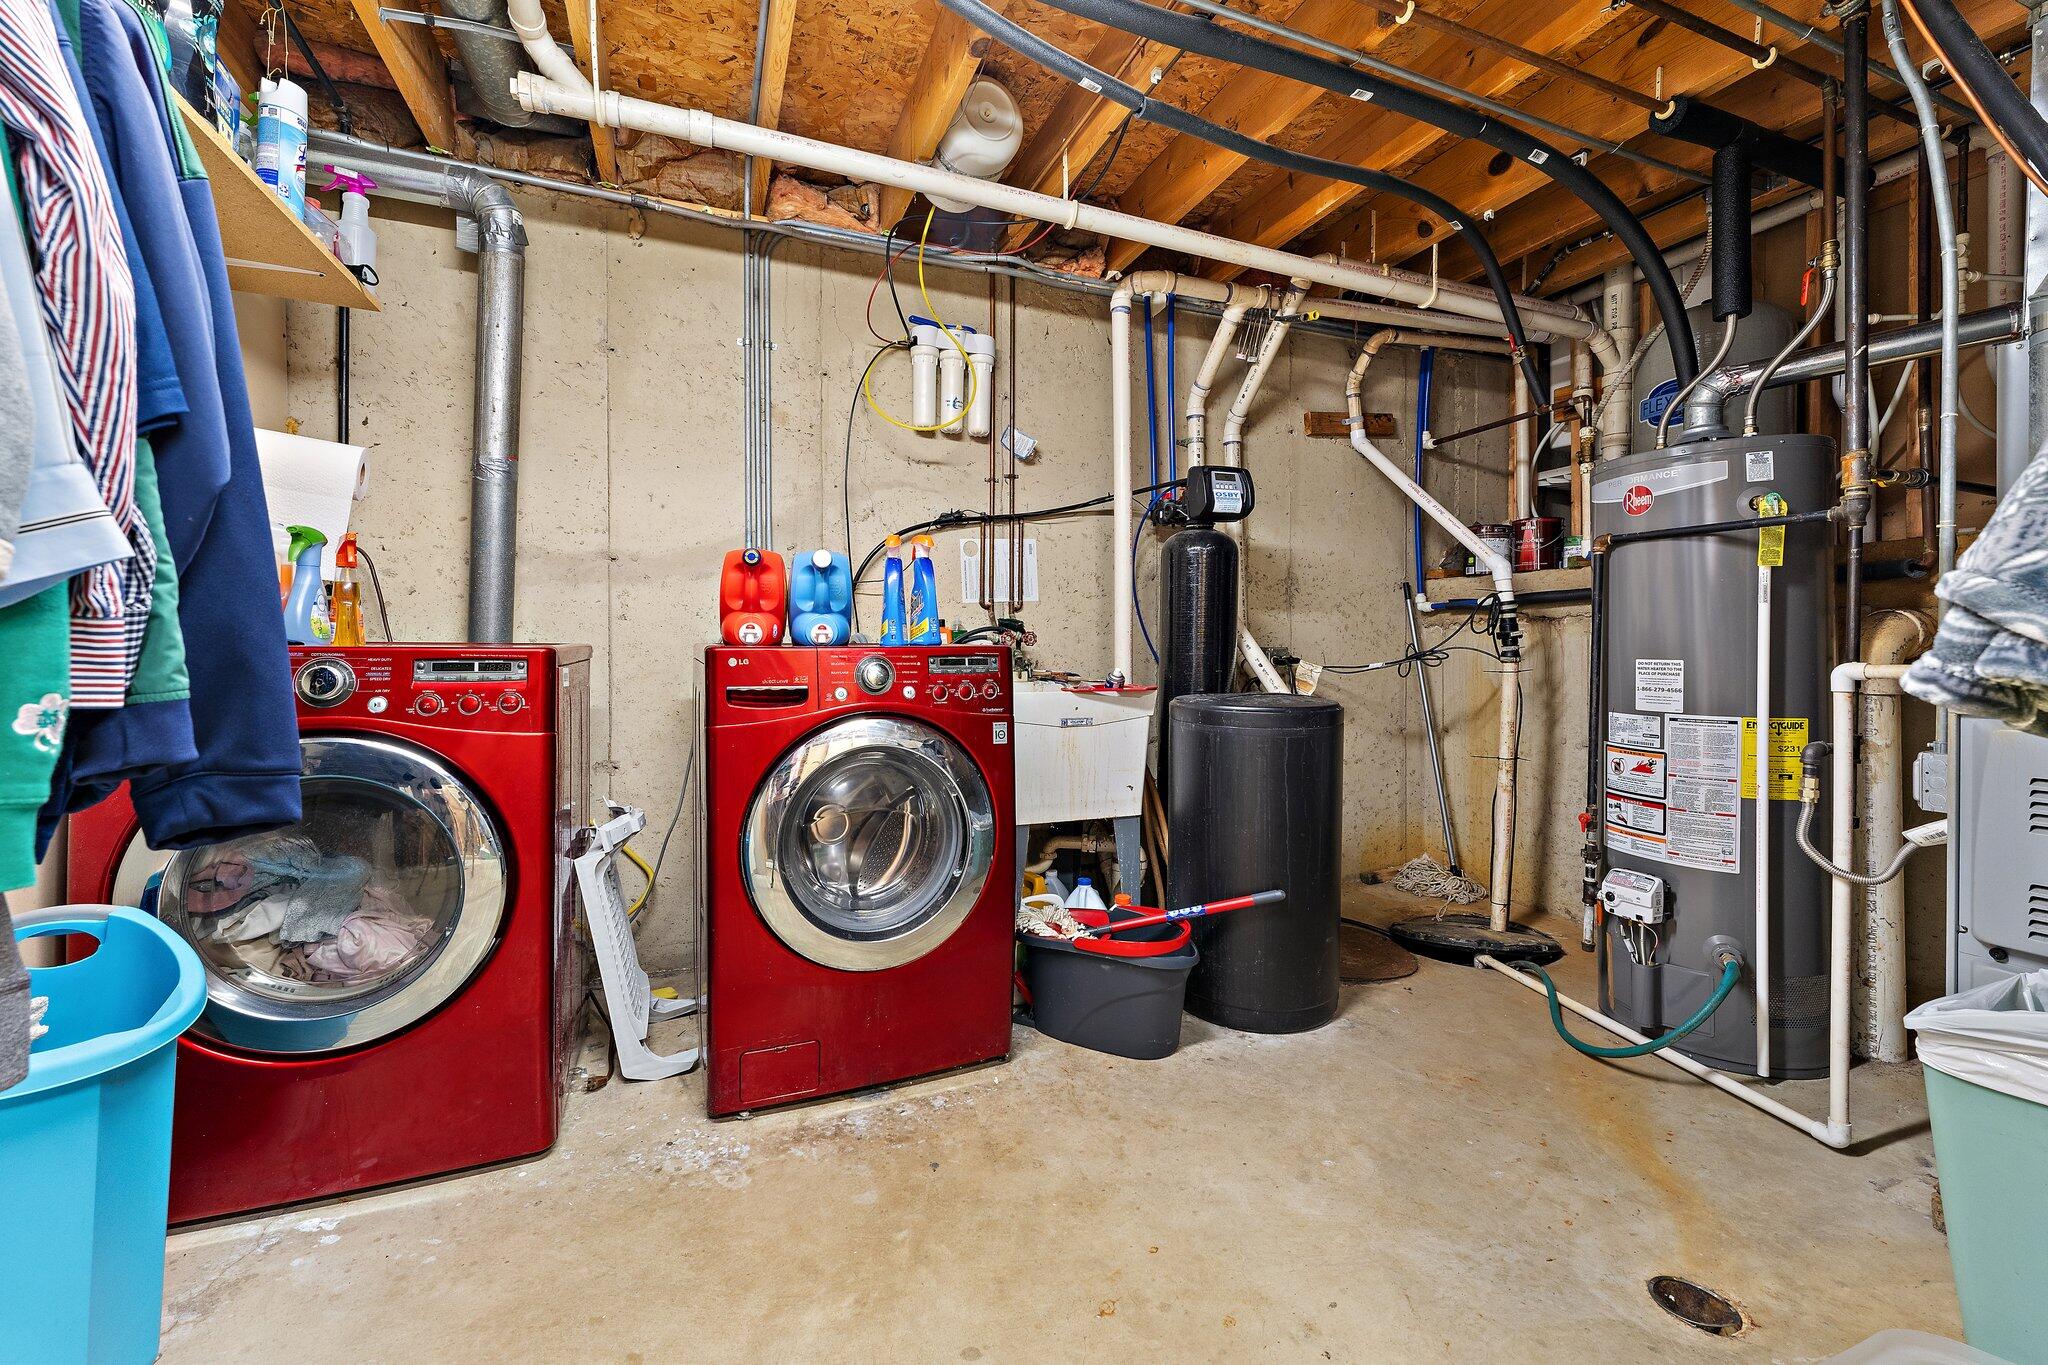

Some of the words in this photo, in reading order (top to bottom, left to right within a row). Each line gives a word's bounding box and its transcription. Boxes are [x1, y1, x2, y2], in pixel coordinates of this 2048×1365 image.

[1608, 470, 1679, 489] PERORMANCE
[1626, 485, 1652, 511] Rheem
[738, 658, 749, 666] LG
[1636, 686, 1683, 694] 1-866-279-4566
[1777, 745, 1801, 753] $231
